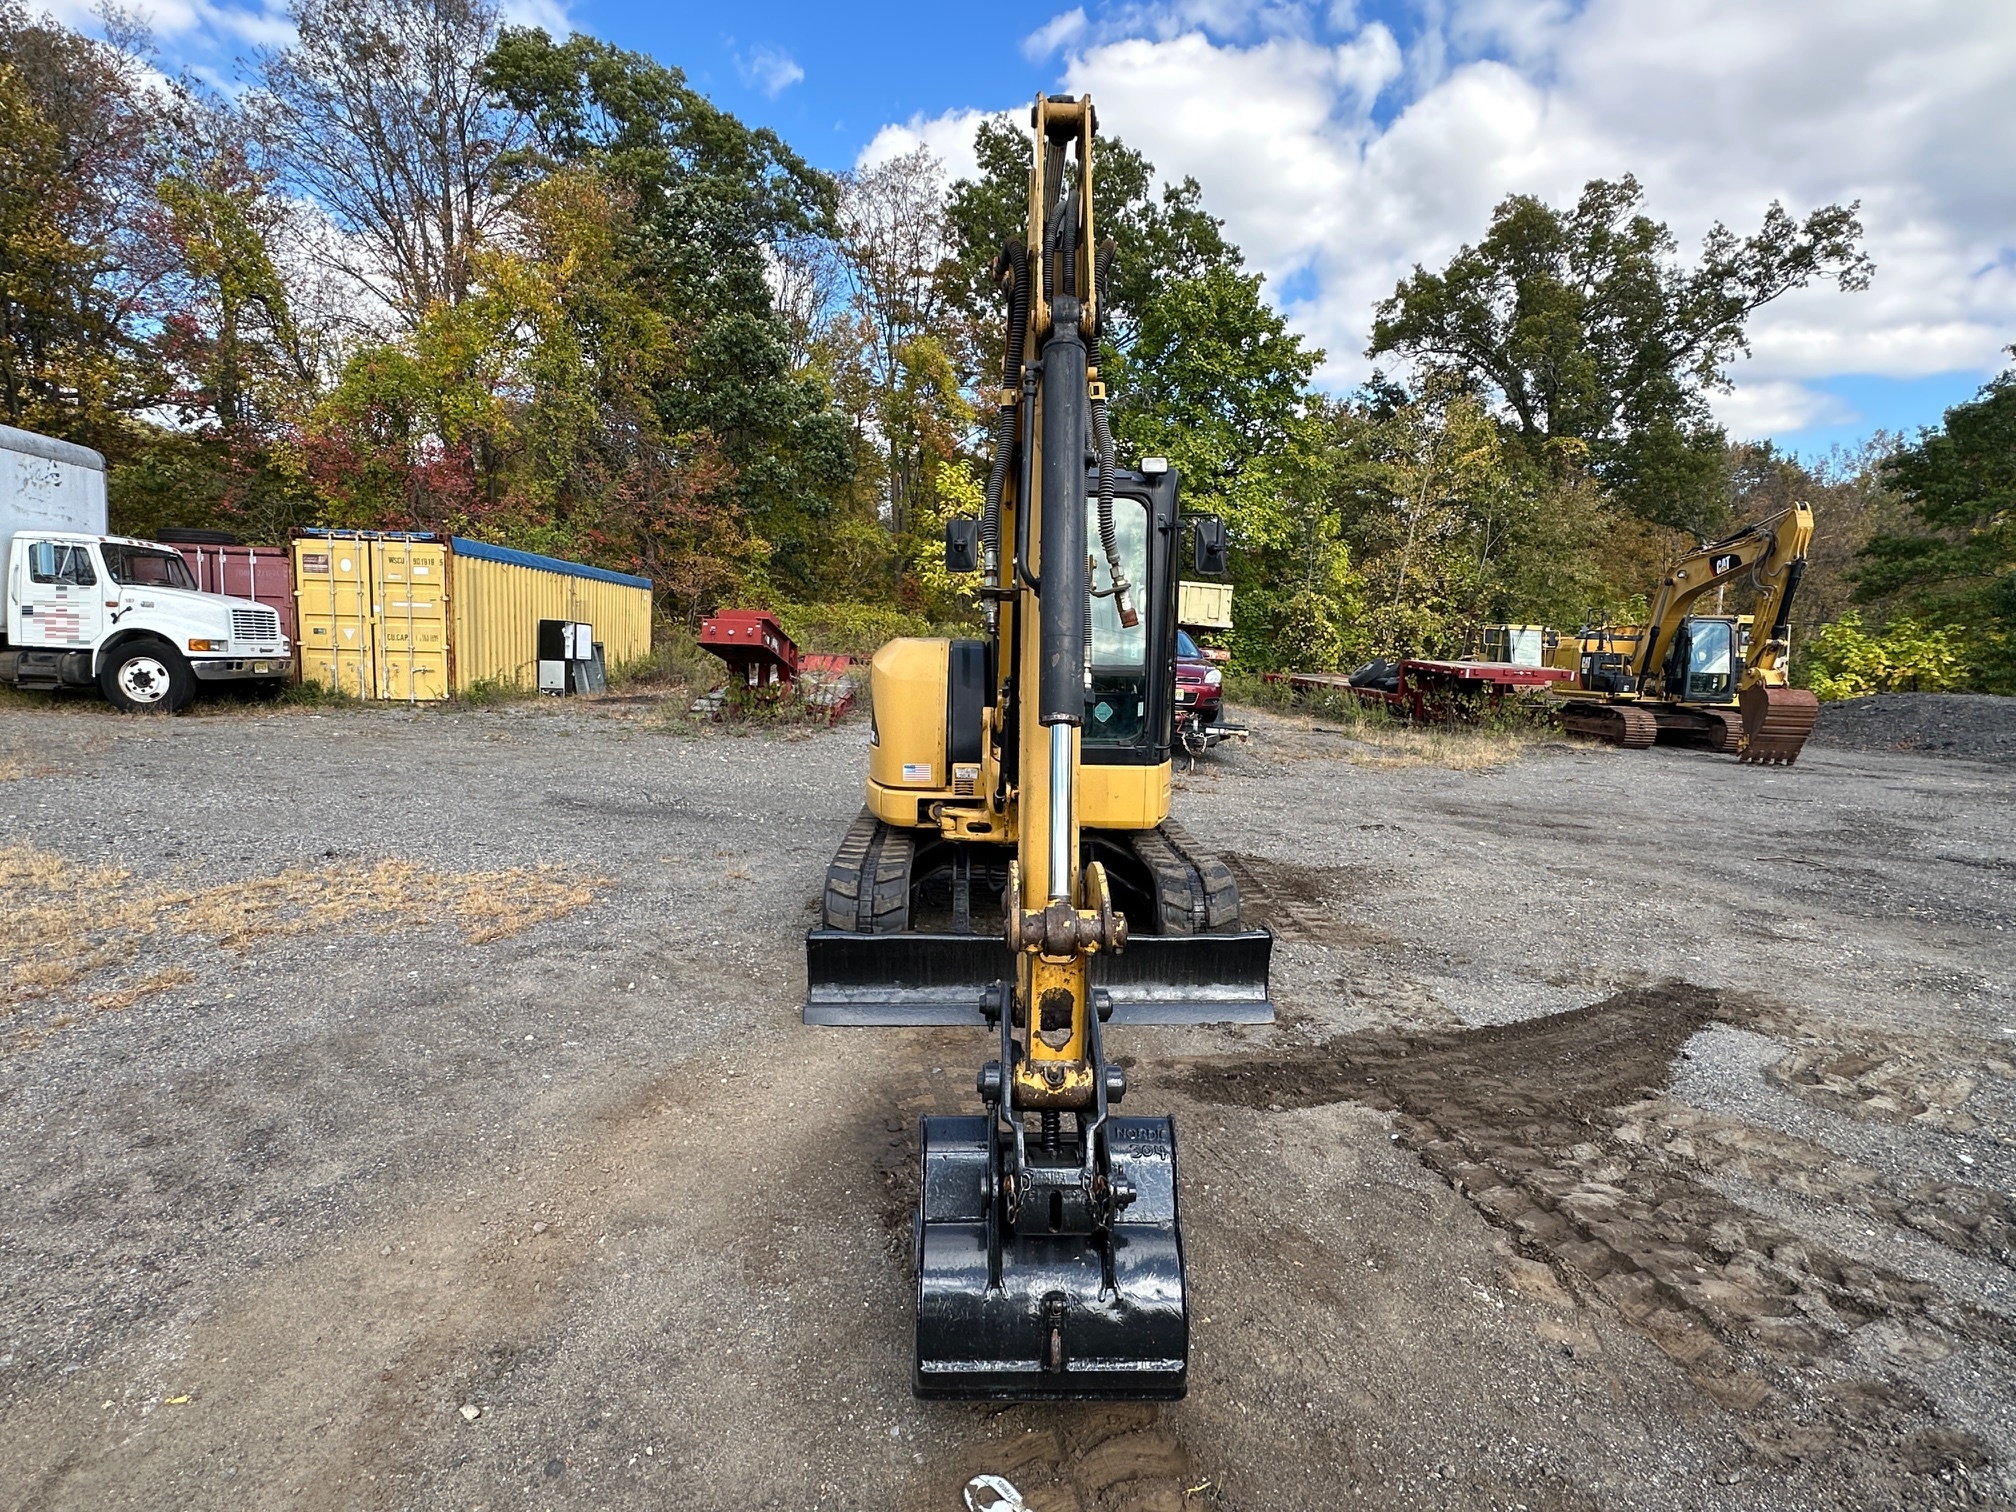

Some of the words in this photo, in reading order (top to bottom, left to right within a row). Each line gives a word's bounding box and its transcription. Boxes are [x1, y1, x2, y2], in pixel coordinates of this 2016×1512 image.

[1716, 555, 1731, 575] CAT
[1114, 1126, 1167, 1142] NORDIC
[1130, 1144, 1168, 1161] 304
